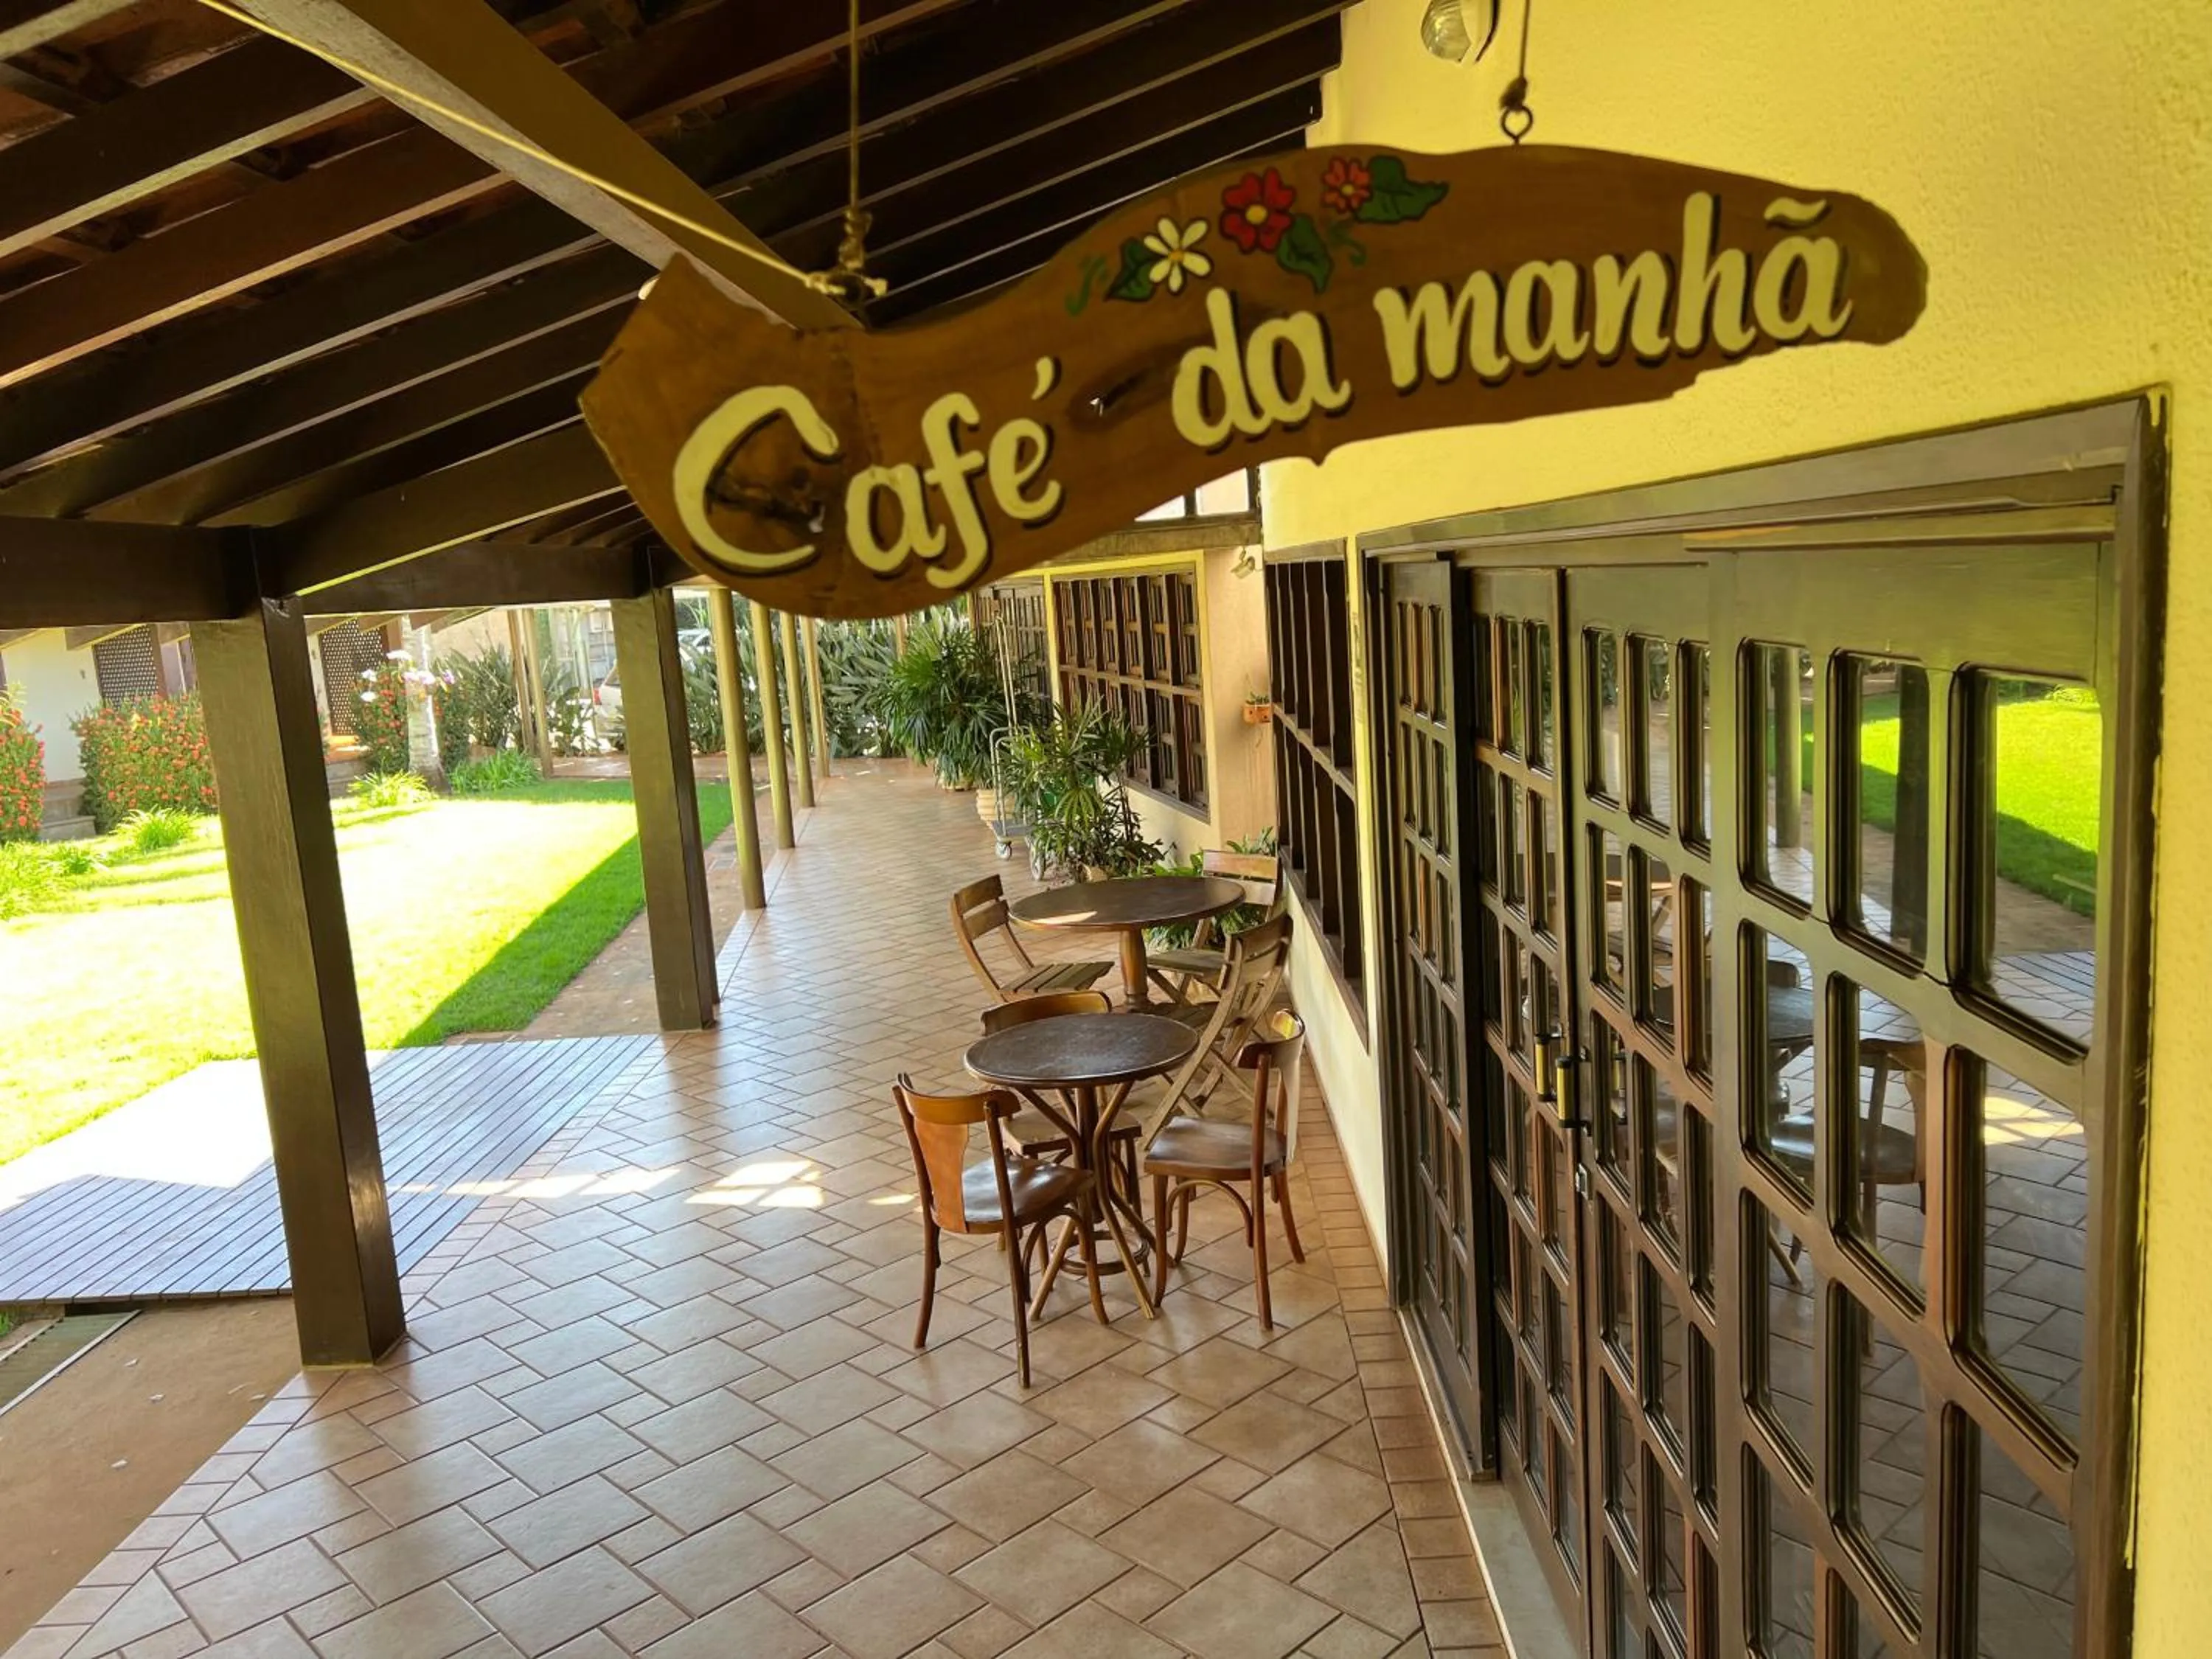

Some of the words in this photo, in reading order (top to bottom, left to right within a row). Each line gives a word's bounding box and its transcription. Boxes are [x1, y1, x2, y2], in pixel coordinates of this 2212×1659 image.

[673, 355, 1062, 590] Café
[1171, 288, 1350, 448] da
[1374, 190, 1854, 388] manhã
